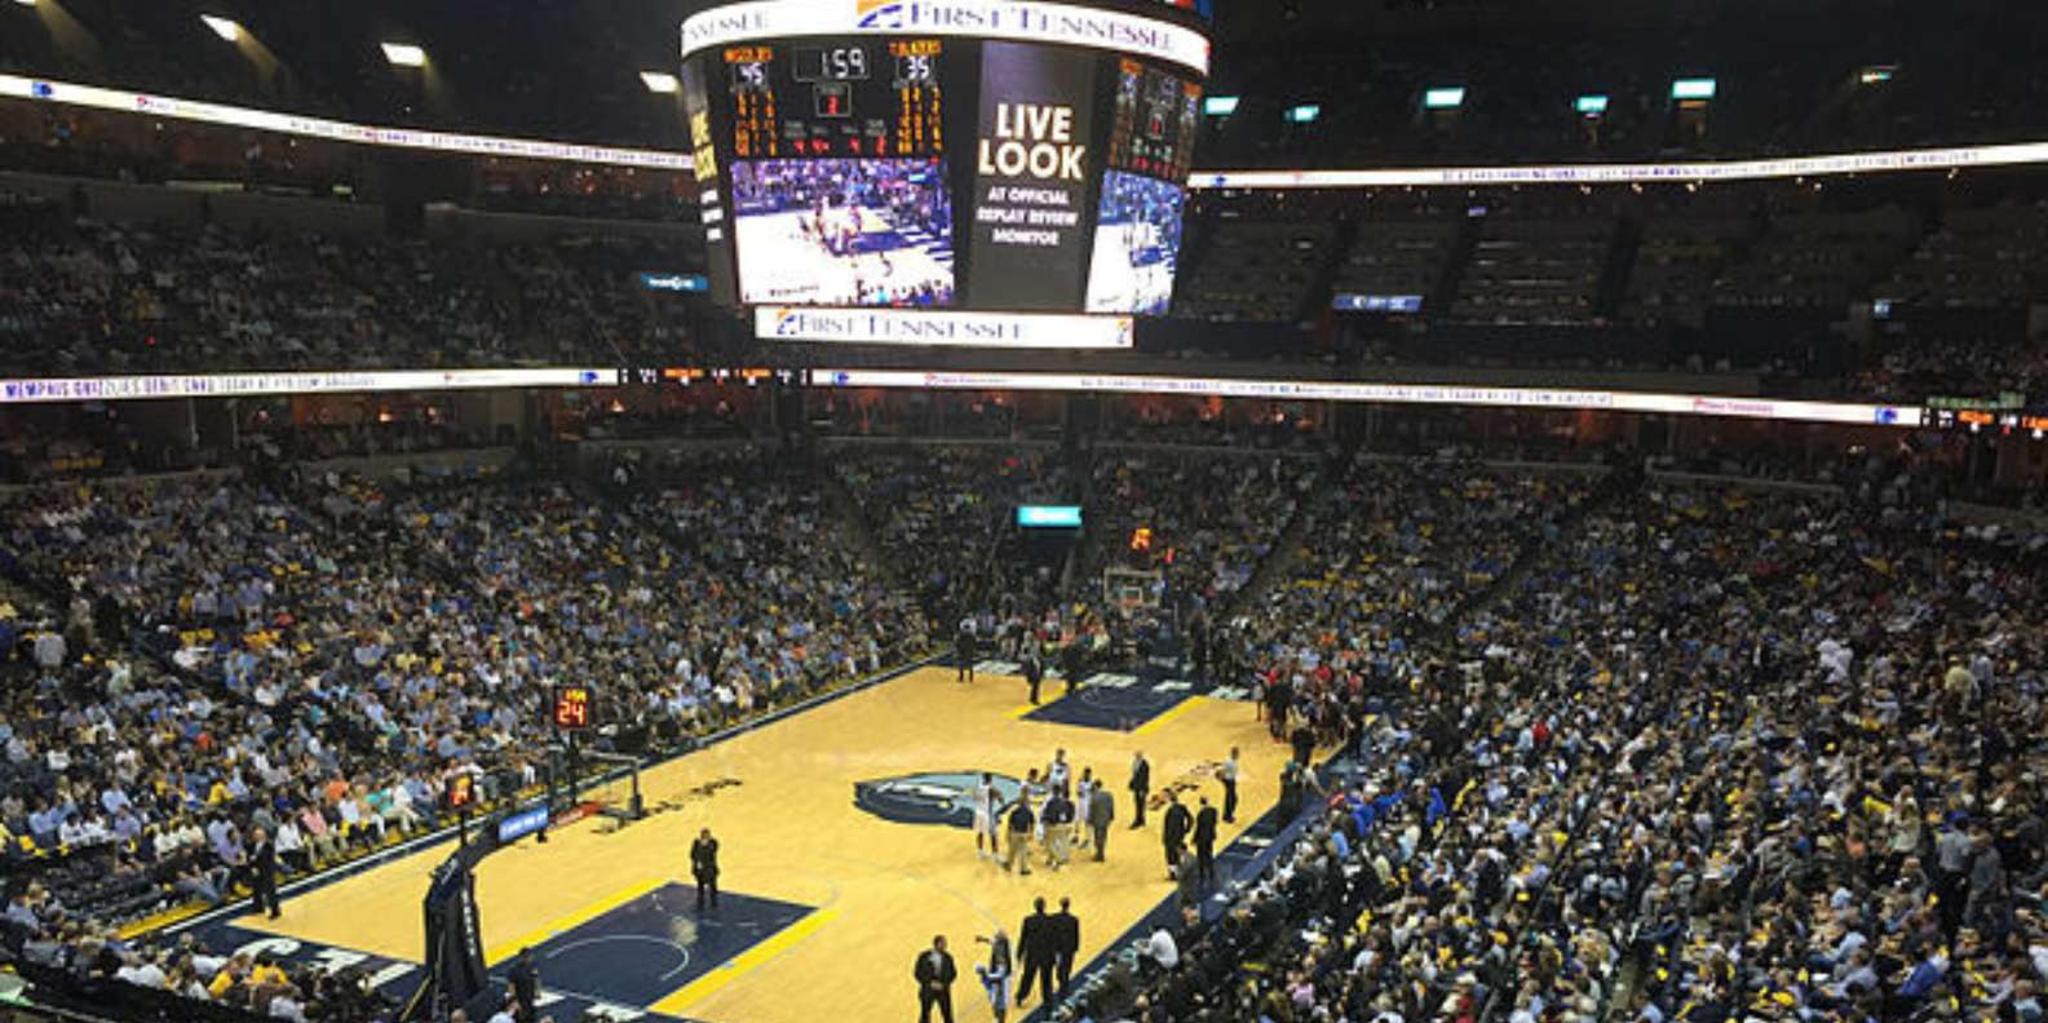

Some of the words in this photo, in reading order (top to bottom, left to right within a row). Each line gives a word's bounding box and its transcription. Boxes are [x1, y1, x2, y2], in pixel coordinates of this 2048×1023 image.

[911, 1, 1000, 28] FIRST
[1011, 4, 1170, 50] TENNESSEE
[740, 61, 762, 86] 45
[908, 55, 929, 80] 35
[997, 103, 1073, 142] LIVE
[978, 138, 1086, 179] LOOK
[988, 187, 1007, 201] AT
[1008, 188, 1070, 205] OFFICIAL
[977, 206, 1026, 223] REPLAY
[1029, 209, 1079, 226] REVIEW
[992, 228, 1060, 246] MONITOR
[800, 314, 855, 334] FIRST
[862, 315, 1020, 340] TENNESSEE
[558, 701, 584, 725] 24
